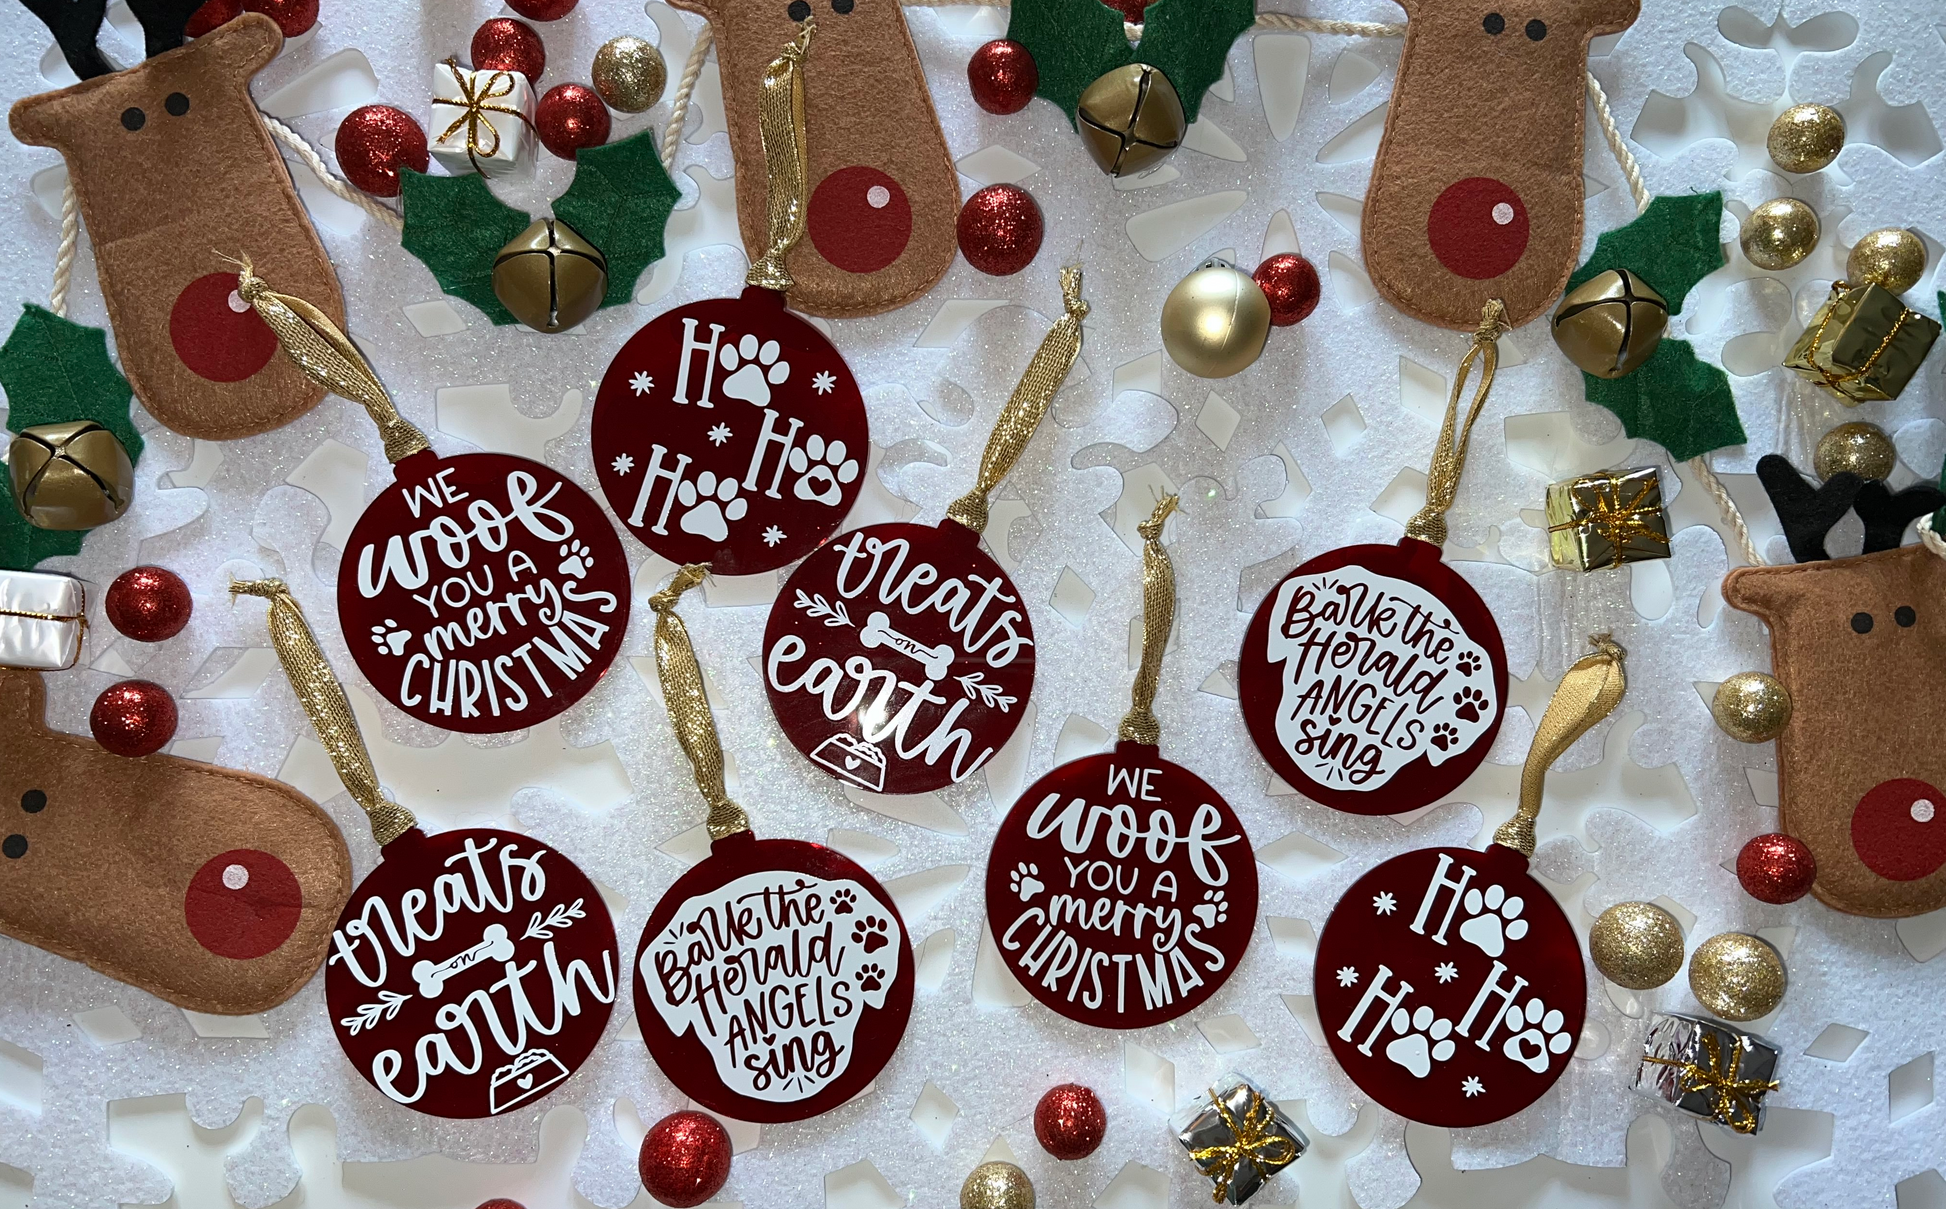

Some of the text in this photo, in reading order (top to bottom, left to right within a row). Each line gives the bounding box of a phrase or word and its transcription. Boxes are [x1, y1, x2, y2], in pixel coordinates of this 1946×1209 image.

[357, 470, 574, 598] woof
[402, 467, 469, 518] WE
[413, 550, 537, 618] YOU A
[423, 578, 562, 660] merry
[833, 532, 1034, 668] treats
[1281, 582, 1460, 665] Bark the
[401, 580, 617, 718] CHRISTMAS
[1294, 627, 1448, 715] Herald
[767, 635, 994, 783] earth
[1290, 675, 1425, 751] ANGELS
[1294, 714, 1386, 785] sing
[1107, 764, 1163, 801] WE
[1026, 793, 1241, 886] woof
[1064, 856, 1177, 902] YOU A
[328, 837, 547, 987] treats
[655, 878, 825, 1007] Bark the
[1049, 894, 1181, 952] merry
[691, 921, 845, 1037] Herald
[1002, 907, 1225, 1013] CHRISTMAS
[372, 941, 615, 1104] earth
[724, 975, 853, 1069] ANGELS
[744, 1030, 845, 1091] sing
